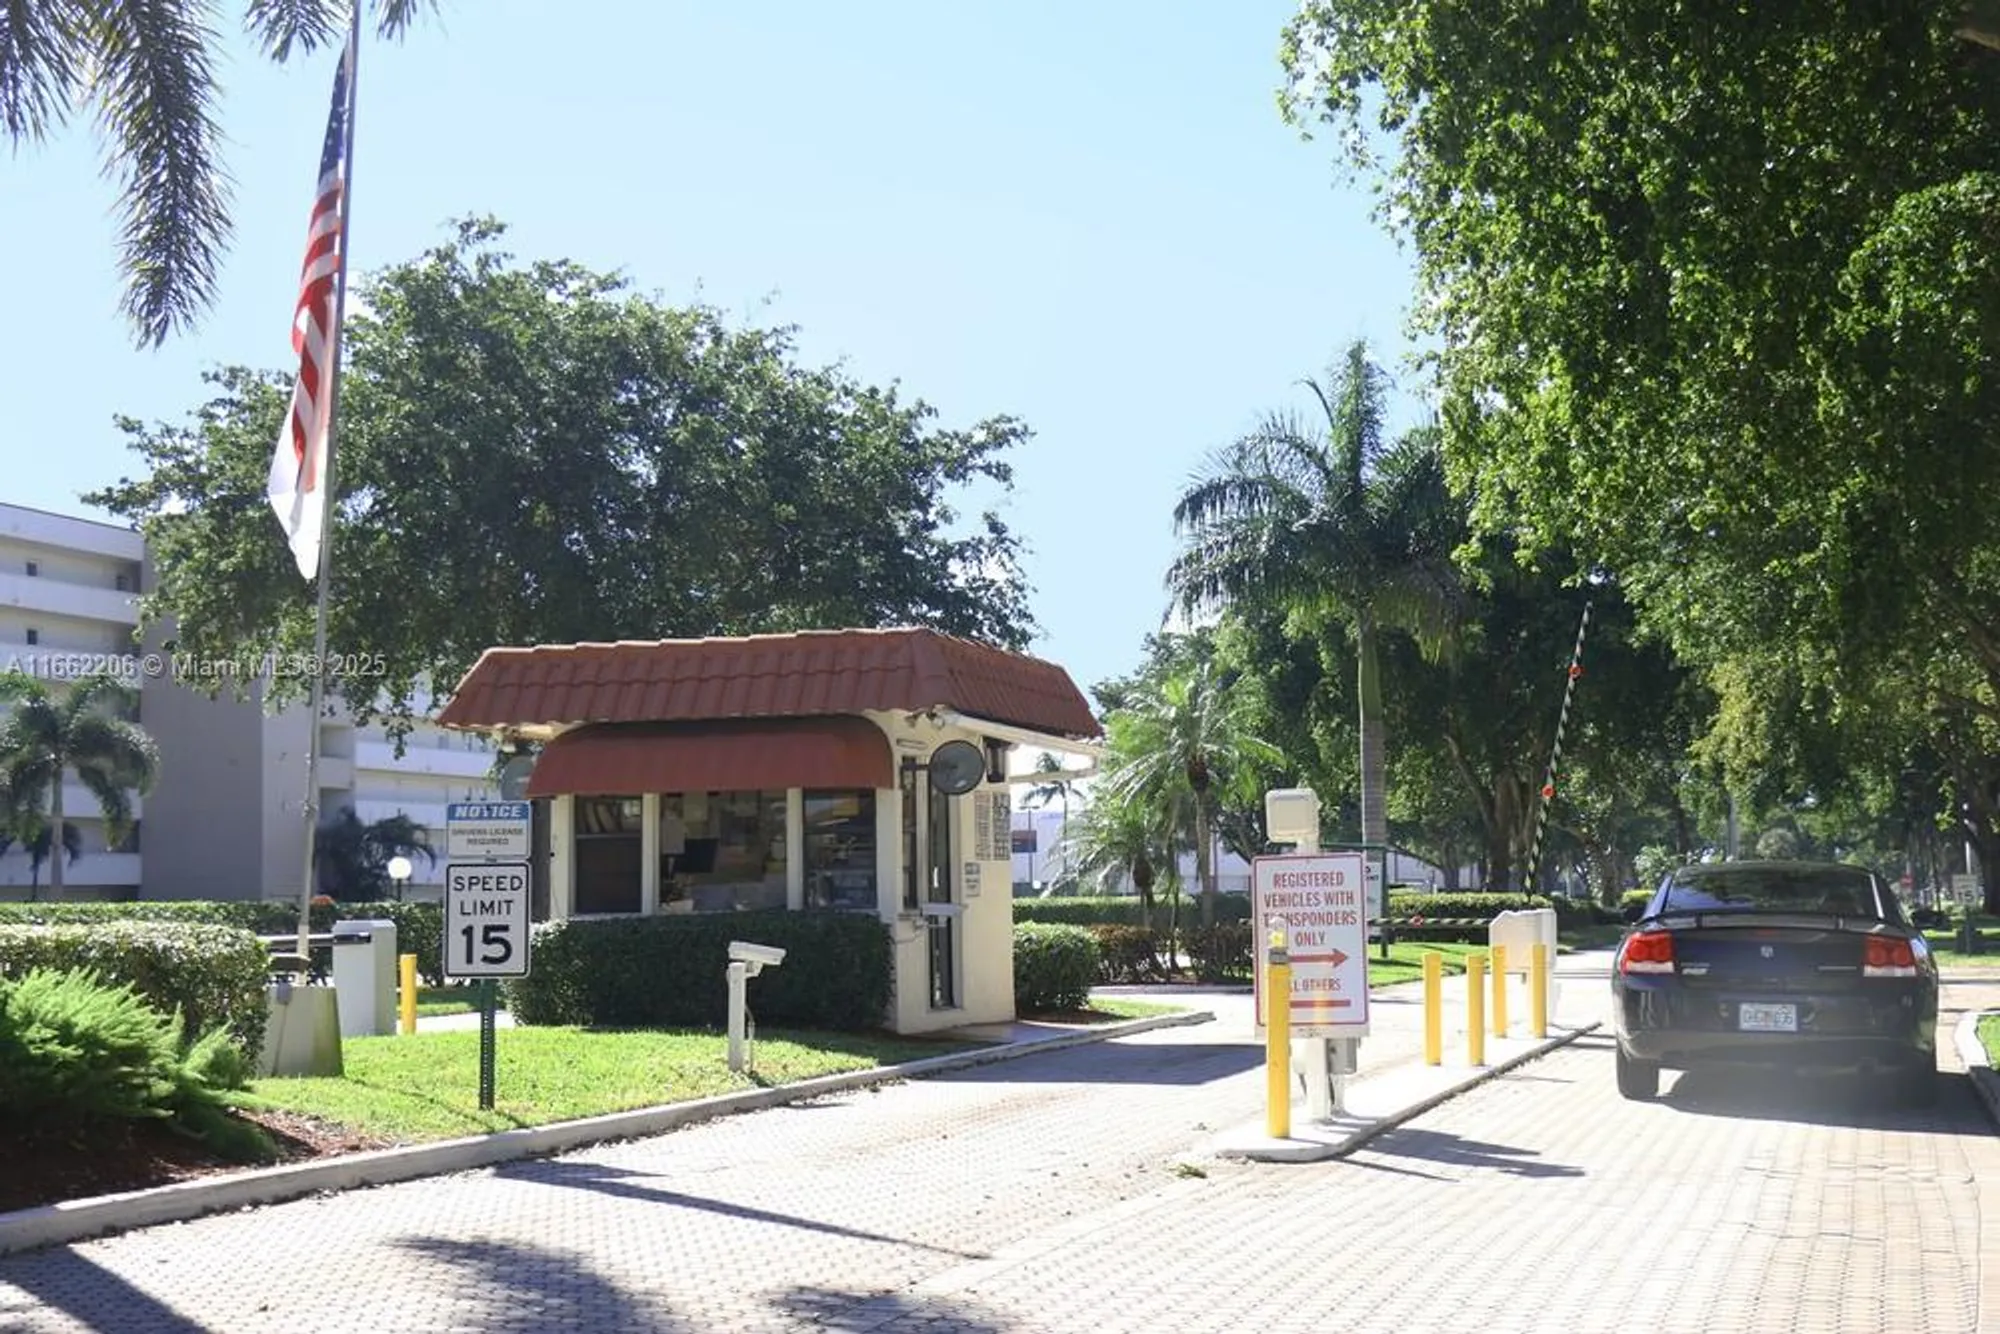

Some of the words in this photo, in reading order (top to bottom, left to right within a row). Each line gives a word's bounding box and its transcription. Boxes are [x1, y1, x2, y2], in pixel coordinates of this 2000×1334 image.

[455, 805, 521, 818] NOTICE
[453, 876, 523, 891] SPEED
[1273, 871, 1345, 888] REGISTERED
[1264, 891, 1321, 907] VEHICLES
[1324, 890, 1355, 905] WITH
[460, 900, 514, 916] LIMIT
[1263, 911, 1357, 927] TNSPONDERS
[461, 924, 512, 965] 15
[1295, 931, 1325, 947] ONLY
[1302, 978, 1342, 992] OTHERS
